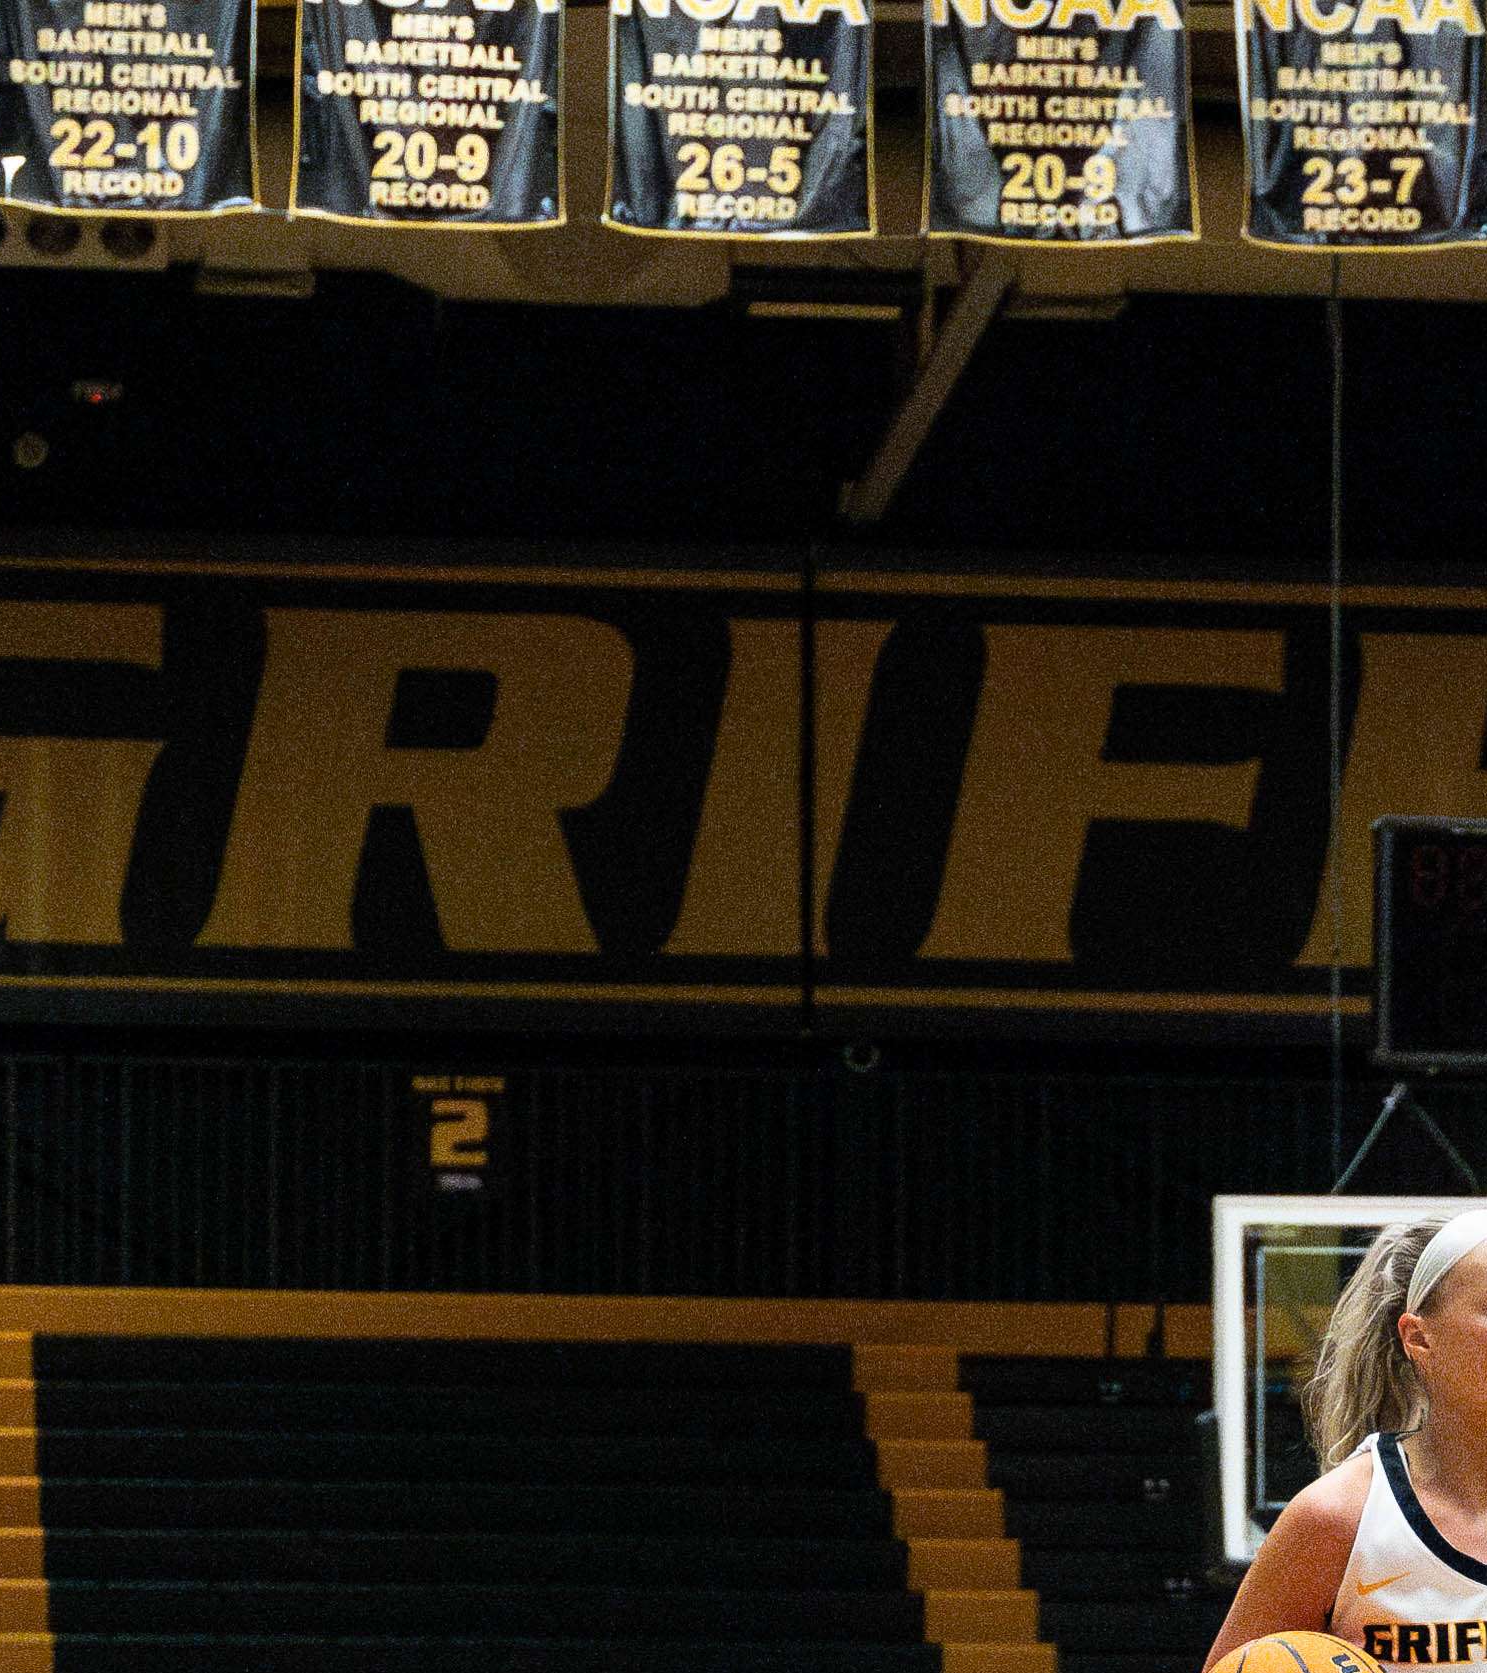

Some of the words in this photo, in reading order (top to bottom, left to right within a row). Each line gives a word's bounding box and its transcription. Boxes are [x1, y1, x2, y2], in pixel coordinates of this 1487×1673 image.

[84, 3, 166, 28] MEN'S
[392, 15, 474, 41] MEN'S
[37, 29, 213, 56] BASKETBALL
[699, 28, 783, 54] MEN'S
[1017, 36, 1099, 62] MEN'S
[1320, 39, 1402, 67] MEN'S
[346, 42, 521, 71] BASKETBALL
[654, 54, 829, 83] BASKETBALL
[10, 59, 102, 85] SOUTH
[111, 62, 240, 90] CENTRAL
[317, 72, 410, 97] SOUTH
[419, 75, 547, 103] CENTRAL
[971, 63, 1144, 91] BASKETBALL
[1277, 67, 1448, 94] BASKETBALL
[54, 89, 197, 116] REGIONAL
[624, 84, 717, 110] SOUTH
[726, 87, 856, 116] CENTRAL
[945, 93, 1037, 119] SOUTH
[1044, 95, 1174, 121] CENTRAL
[1250, 97, 1340, 123] SOUTH
[1349, 99, 1477, 126] CENTRAL
[360, 100, 504, 129] REGIONAL
[668, 113, 812, 141] REGIONAL
[50, 120, 200, 170] 22-10
[988, 121, 1128, 149] REGIONAL
[1294, 127, 1434, 152] REGIONAL
[371, 131, 490, 182] 20-9
[674, 144, 802, 194] 26-5
[63, 171, 183, 198] RECORD
[1000, 153, 1116, 203] 20-9
[1302, 156, 1425, 206] 23-7
[370, 182, 490, 208] RECORD
[677, 194, 798, 220] RECORD
[1001, 203, 1118, 229] RECORD
[1303, 207, 1422, 233] RECORD
[430, 1098, 490, 1168] 2
